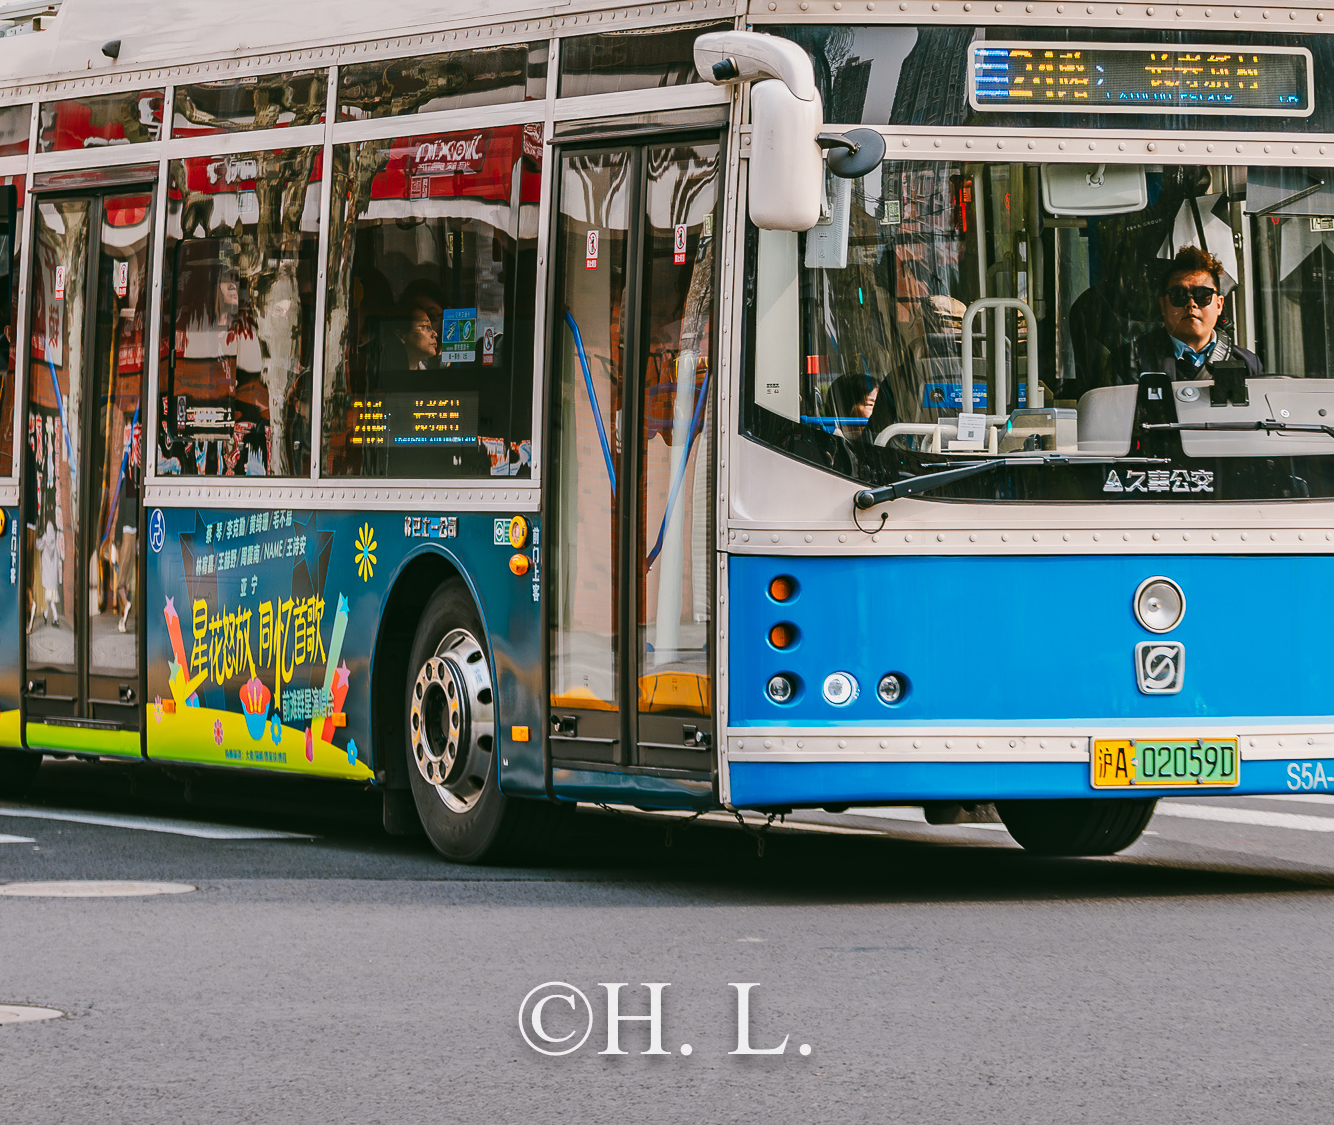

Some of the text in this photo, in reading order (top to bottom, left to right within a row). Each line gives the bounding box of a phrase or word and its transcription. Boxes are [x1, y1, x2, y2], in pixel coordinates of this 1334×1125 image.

[1125, 469, 1215, 493] 久事公交
[532, 527, 540, 602] 前门上客
[1099, 746, 1235, 778] 沪A 02059D
